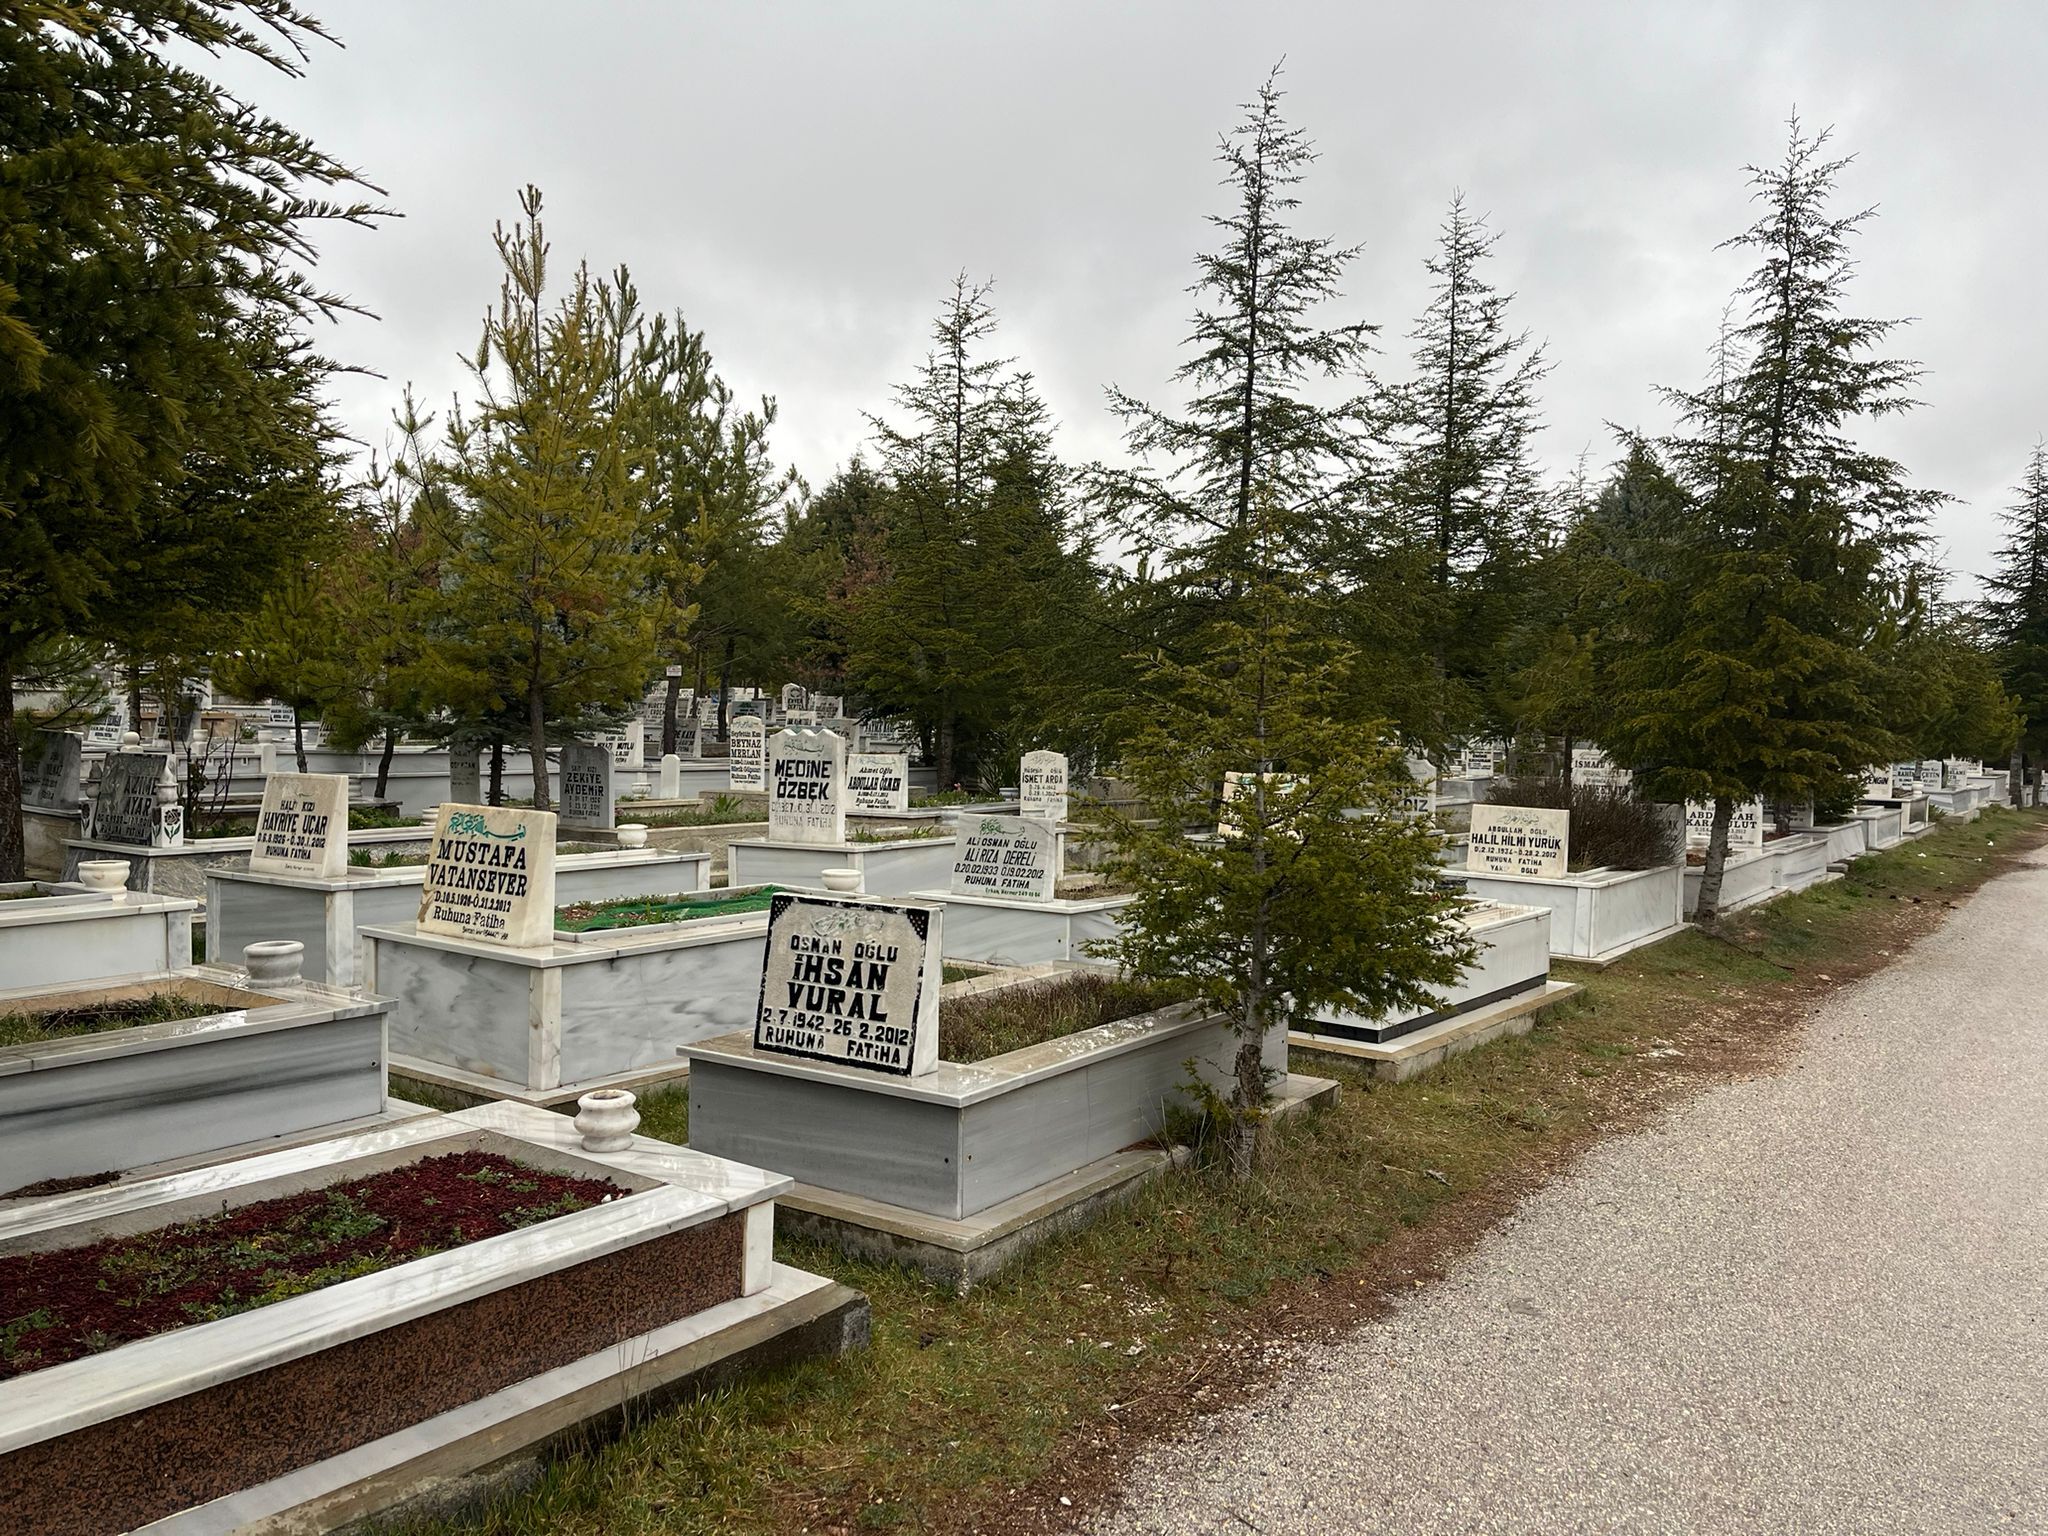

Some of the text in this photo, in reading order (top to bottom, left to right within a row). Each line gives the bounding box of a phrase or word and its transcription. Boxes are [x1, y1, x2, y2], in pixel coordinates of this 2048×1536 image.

[731, 739, 761, 748] BEYNAZ
[731, 749, 761, 758] MERLAN
[775, 759, 832, 778] MEDİNE
[567, 772, 601, 784] ZEKİYE
[1022, 772, 1063, 784] İSMET ARDA
[564, 784, 604, 796] AYDEMİR
[777, 777, 829, 800] ÖZBEK
[124, 796, 152, 816] AYAR
[262, 811, 299, 833] HAYRİYE
[1488, 826, 1522, 834] ABDULLAH
[966, 837, 1037, 850] ALİ OSMAN OĞLU
[1471, 832, 1499, 845] HALİL
[1501, 833, 1526, 847] HİLMİ
[265, 845, 288, 857] RUHUNA
[437, 839, 526, 870] MUSTAFA
[964, 848, 1036, 866] ALİ RIZA DERELİ
[1485, 856, 1542, 866] RUHUNA FATİHA
[429, 863, 528, 897] VATANSEVER
[964, 875, 1030, 889] RUHUNA FATİHA
[433, 905, 505, 929] Ruhuna Fatiha
[790, 934, 899, 963] OSMAN OĞLU
[792, 953, 889, 992] İHSAN
[786, 982, 888, 1023] VURAL
[765, 1025, 901, 1065] RUHUNA FATİHA
